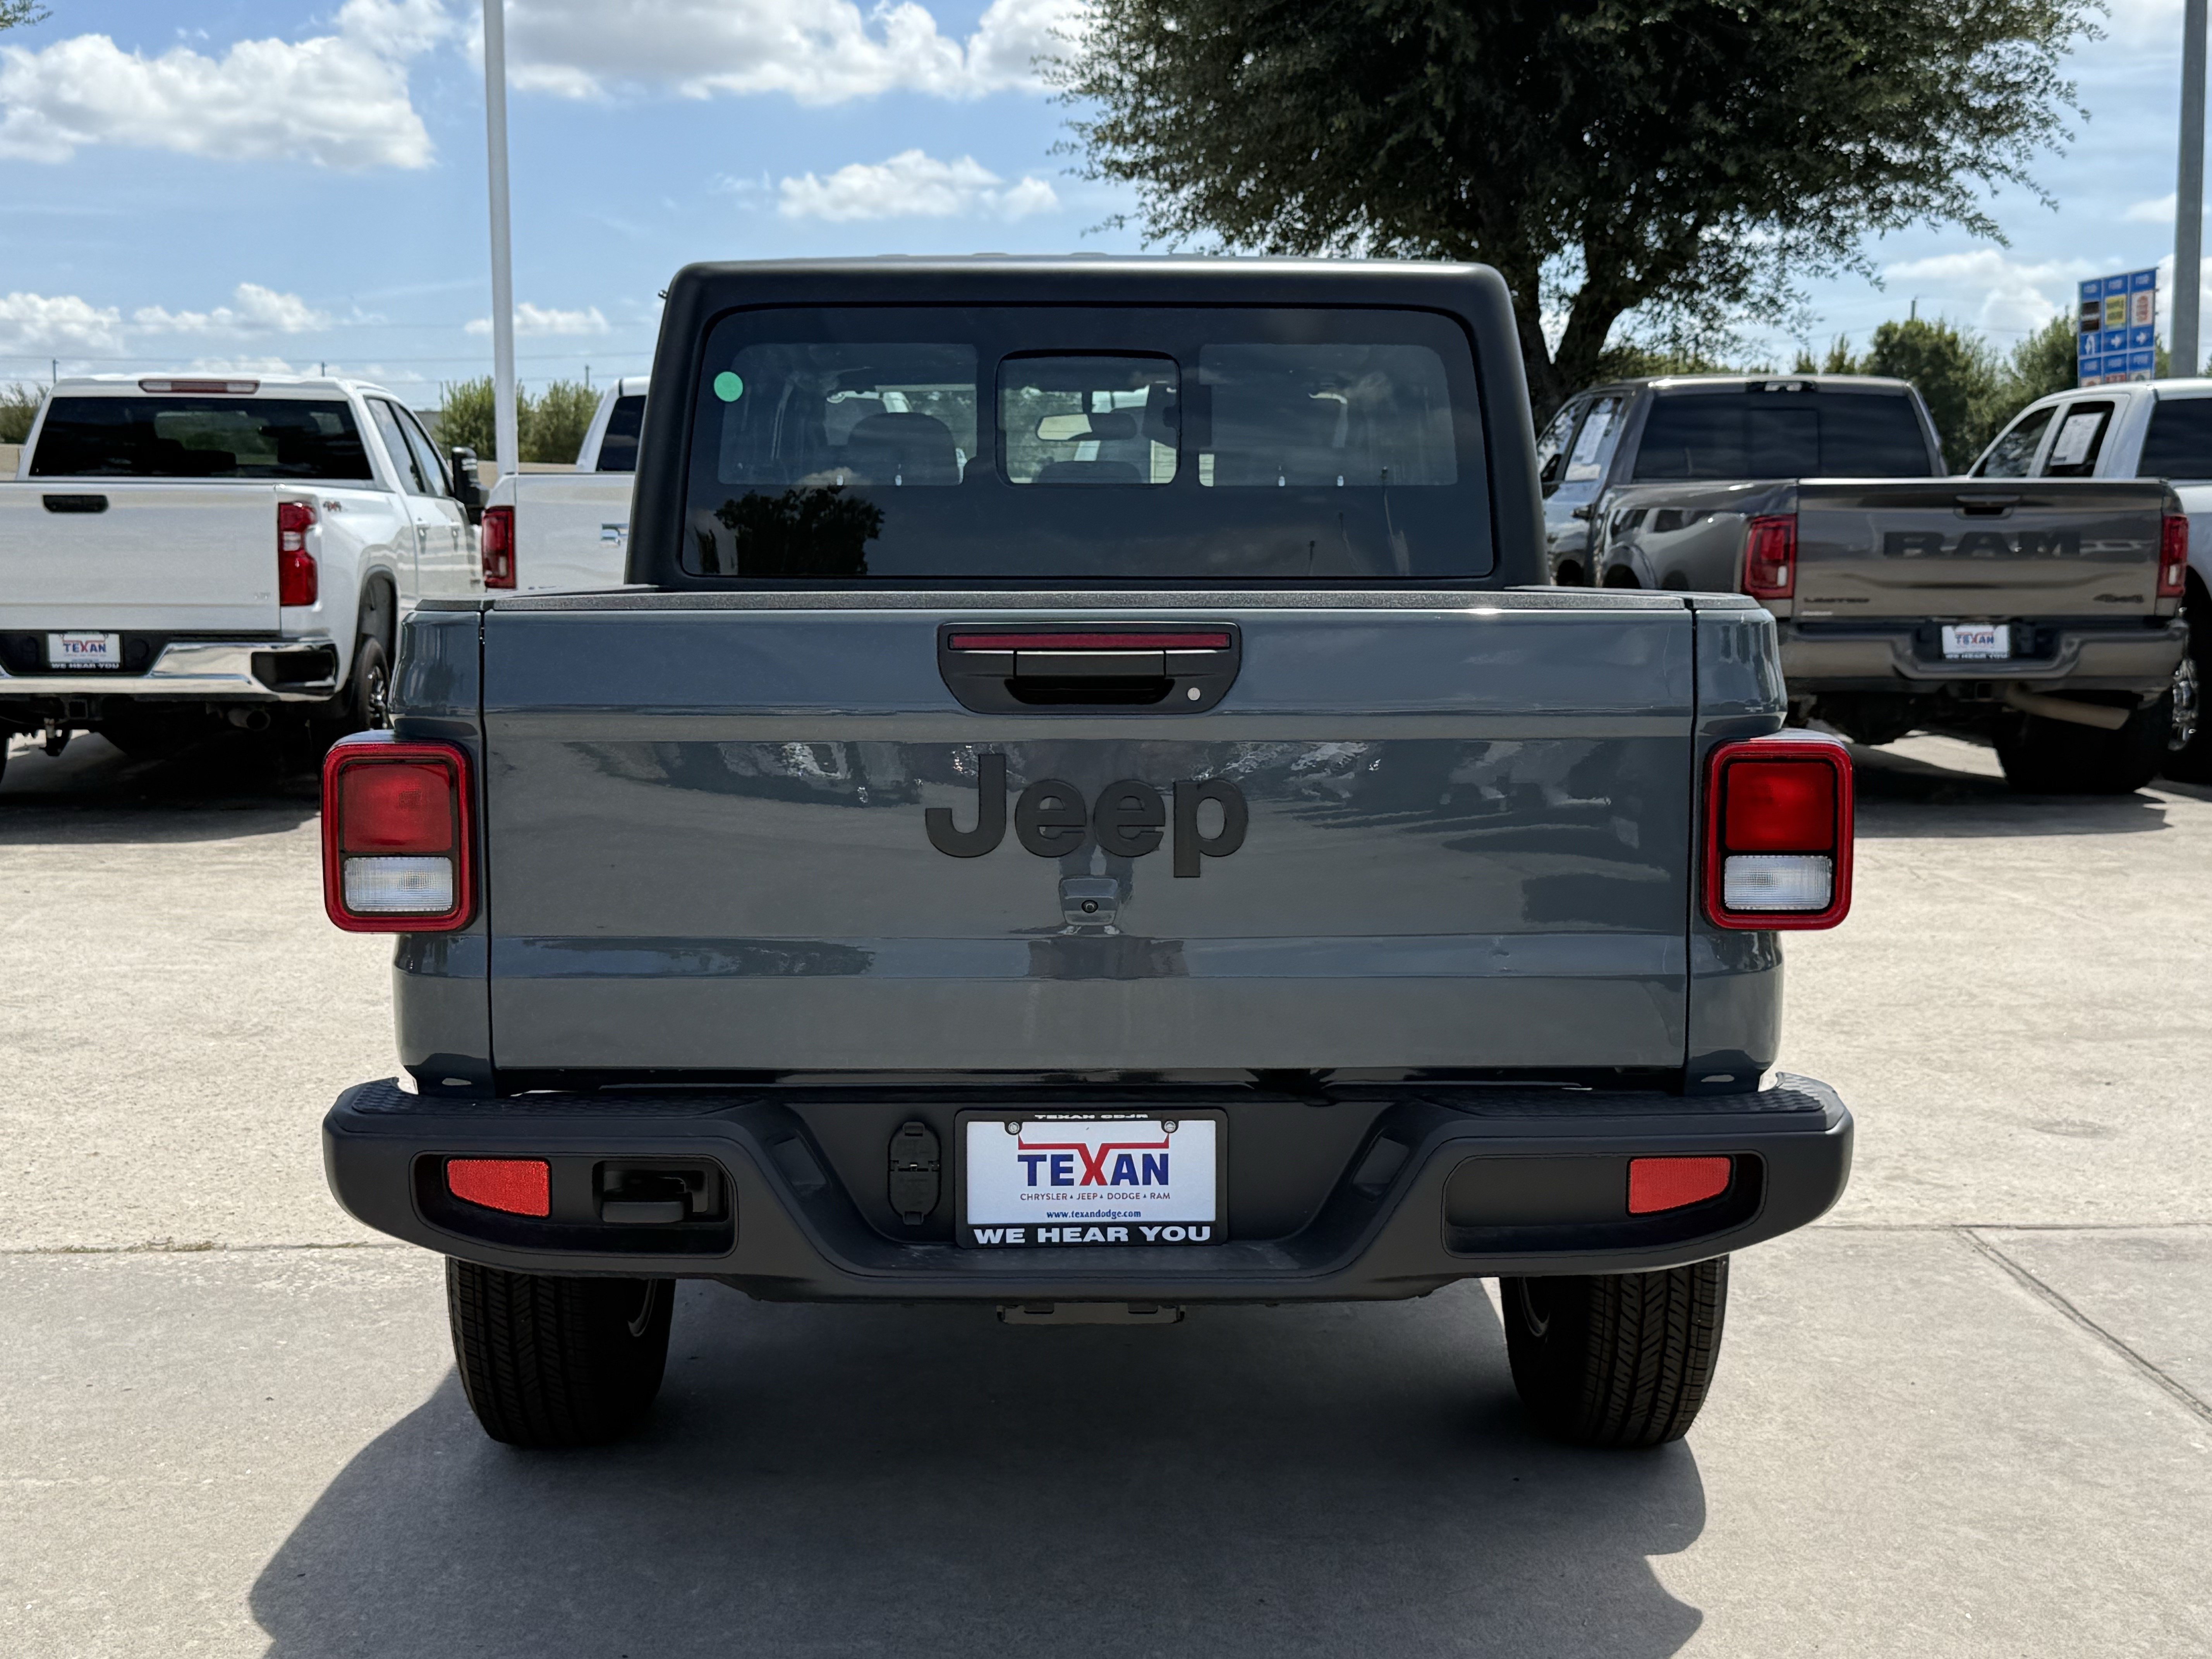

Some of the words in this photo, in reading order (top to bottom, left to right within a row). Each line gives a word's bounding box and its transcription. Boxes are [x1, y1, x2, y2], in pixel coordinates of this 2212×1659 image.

[1884, 531, 2080, 557] RAM
[63, 641, 106, 653] TEXAN
[925, 753, 1249, 878] Jeep
[1017, 1142, 1169, 1187] TEXAN
[1046, 1209, 1141, 1219] www.texandodge.com
[973, 1228, 1025, 1245] WE
[1037, 1227, 1129, 1243] HEAR
[1139, 1226, 1211, 1242] YOU
